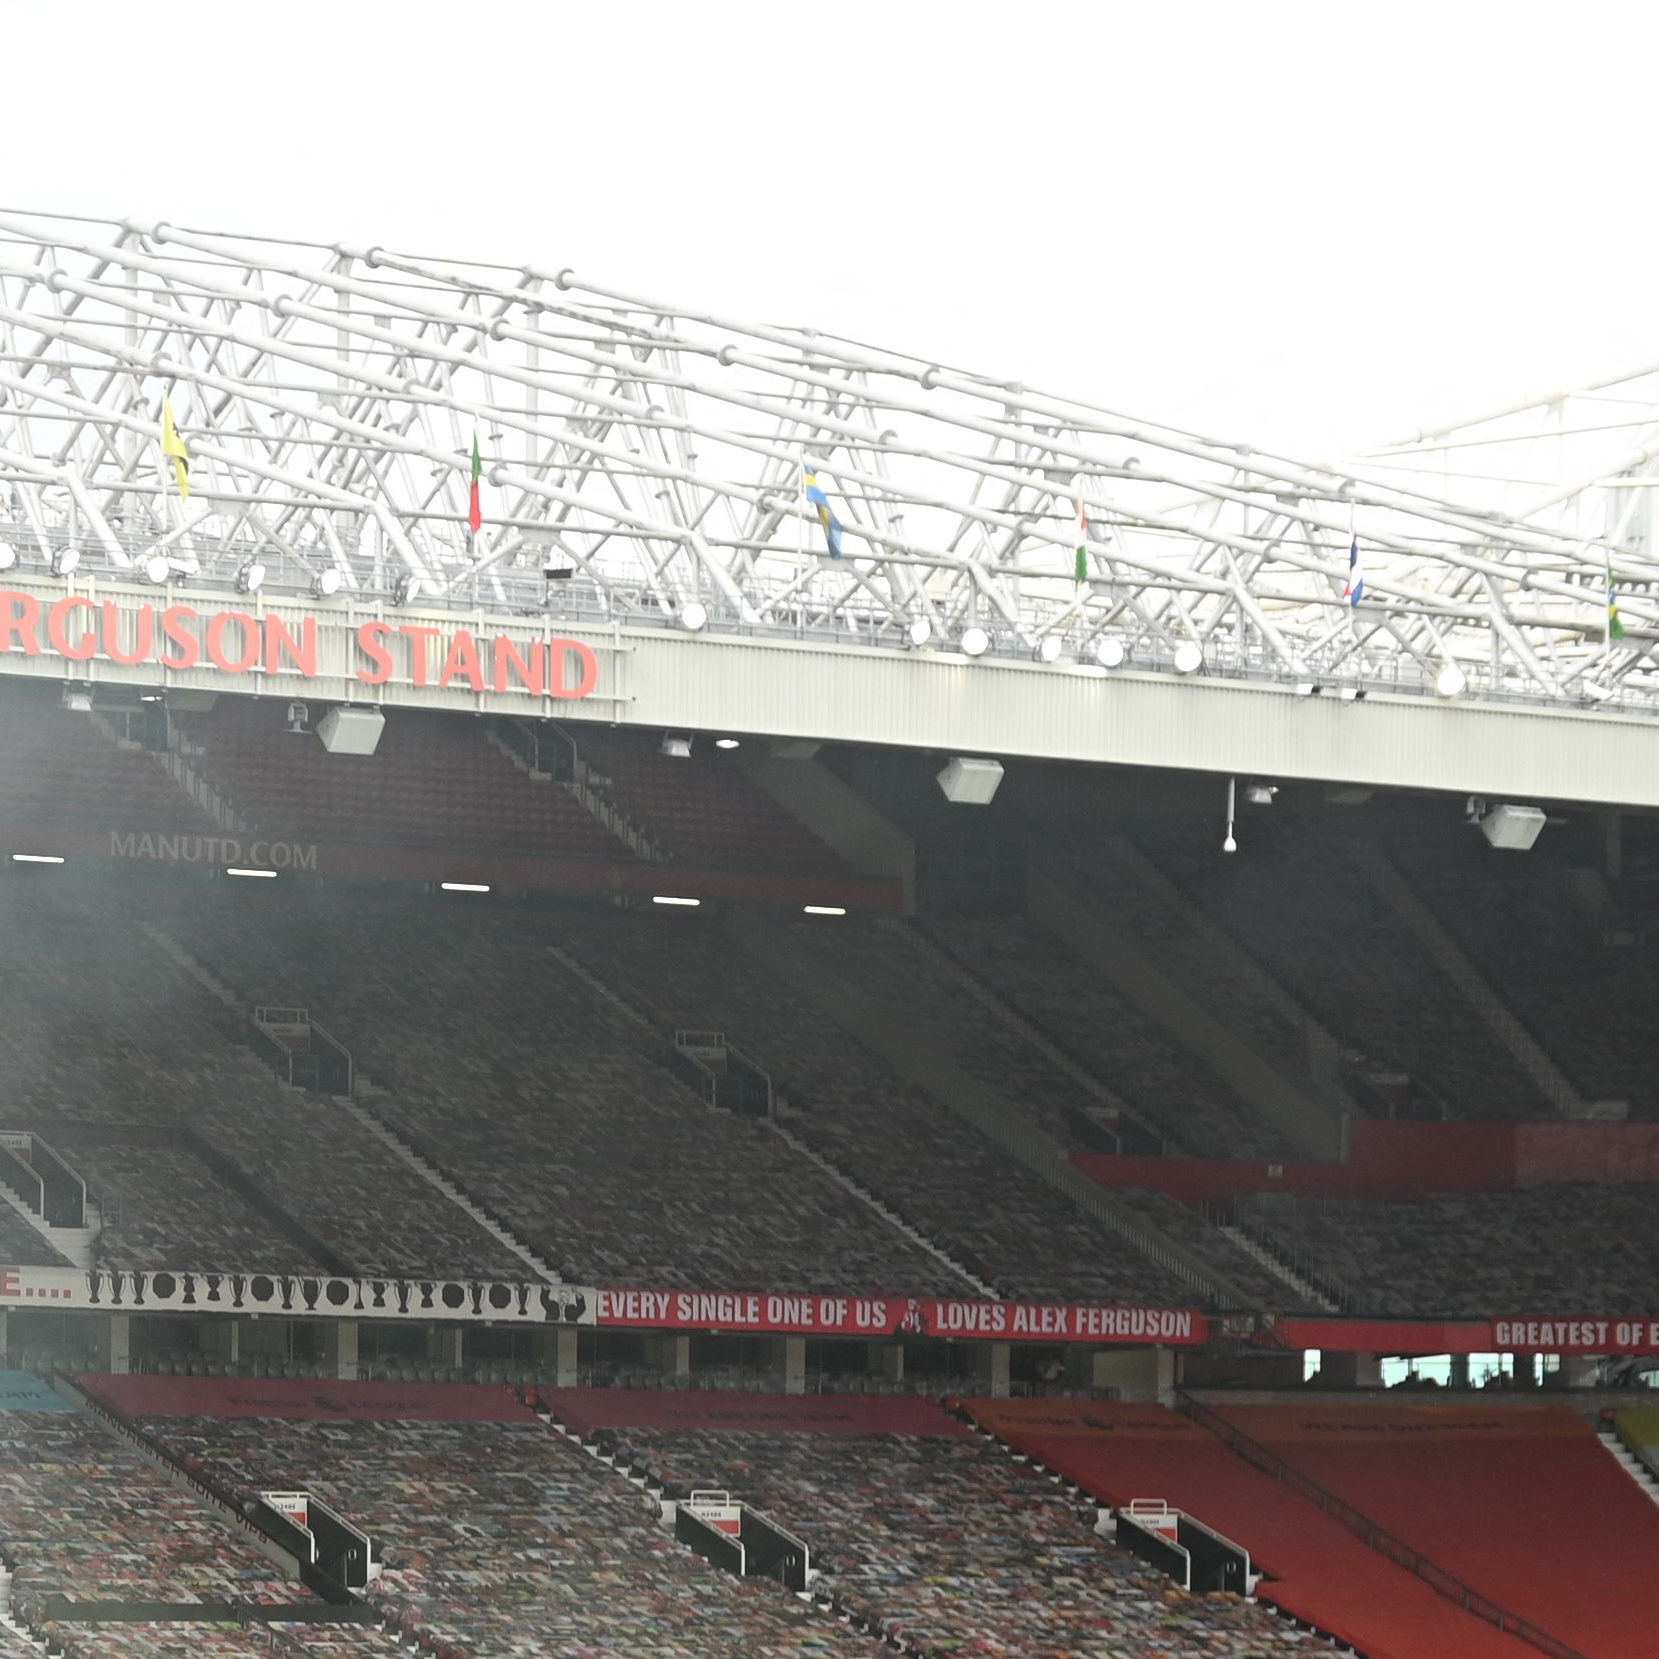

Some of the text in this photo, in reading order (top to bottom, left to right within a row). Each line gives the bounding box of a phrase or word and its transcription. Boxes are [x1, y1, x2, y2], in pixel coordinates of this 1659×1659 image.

[357, 621, 599, 699] STAND
[109, 831, 319, 870] MANUTD.COM
[595, 1290, 887, 1328] EVERY SINGLE ONE OF US
[936, 1302, 1192, 1338] LOVES ALEX FERGUSON
[1495, 1321, 1610, 1347] GREATEST
[1616, 1322, 1643, 1347] OF
